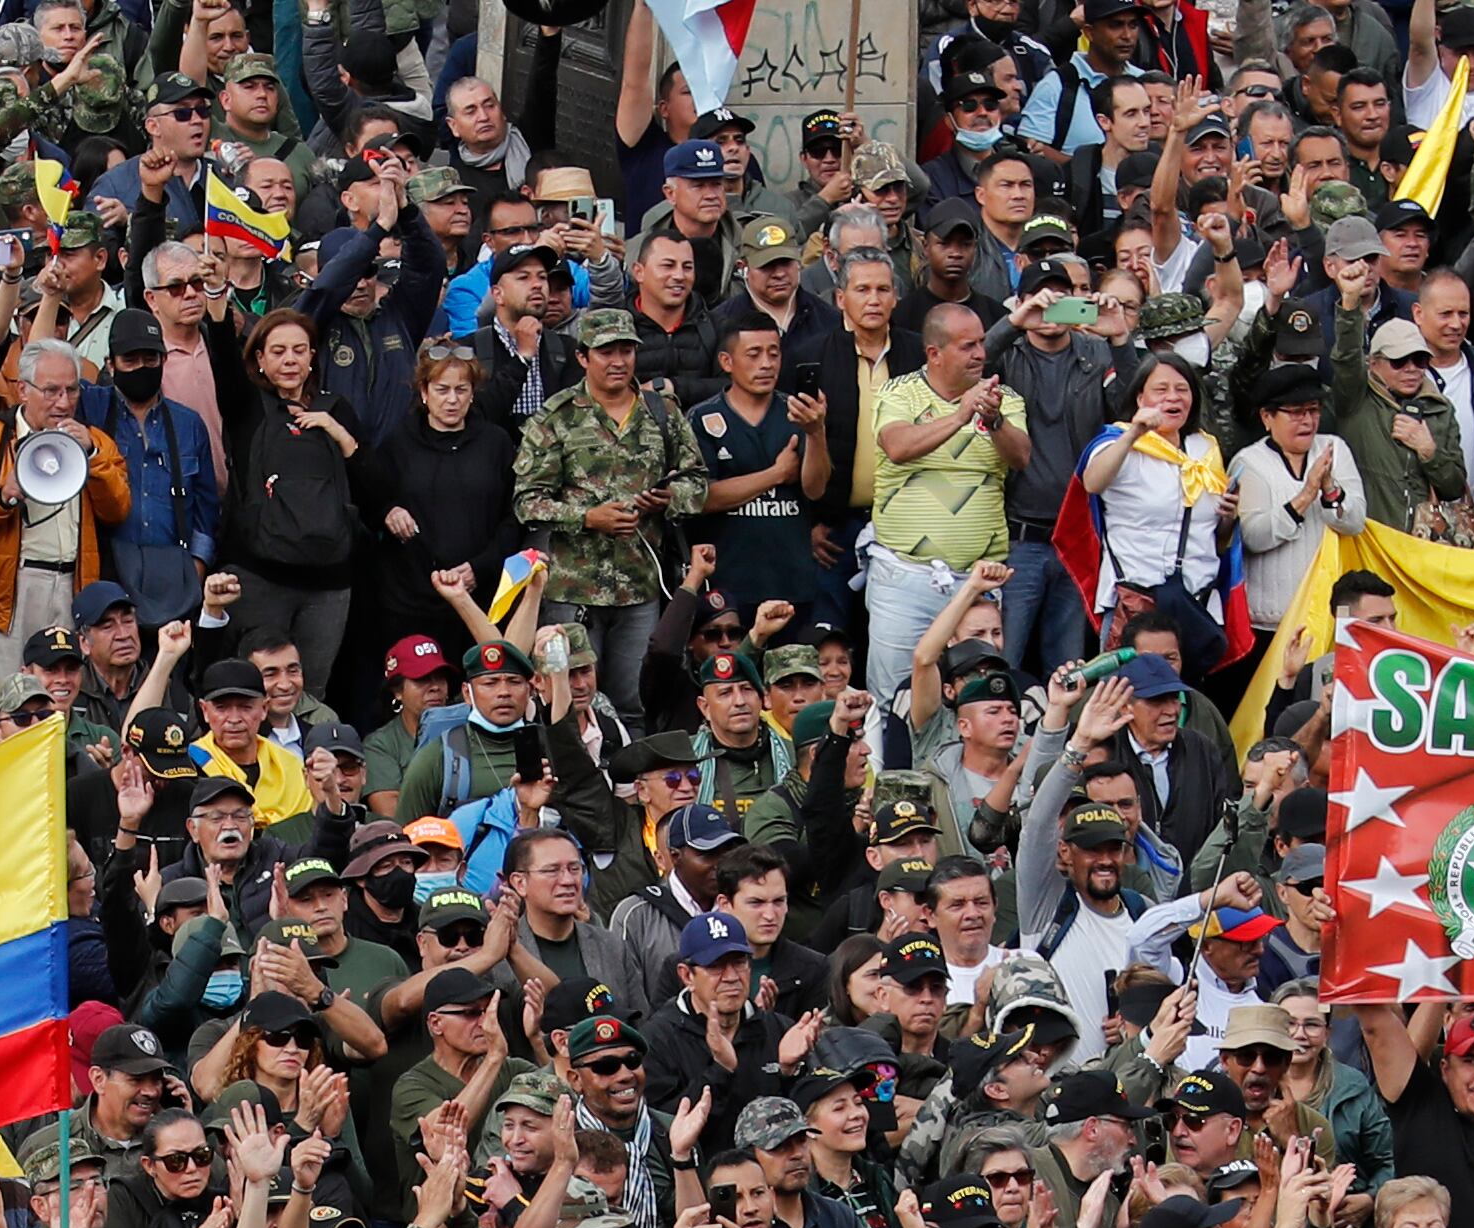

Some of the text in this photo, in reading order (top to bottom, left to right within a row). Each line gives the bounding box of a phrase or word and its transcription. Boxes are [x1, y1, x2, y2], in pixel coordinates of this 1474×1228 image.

[727, 497, 799, 517] mirates
[285, 858, 335, 881] POLICIA
[706, 916, 729, 940] LA
